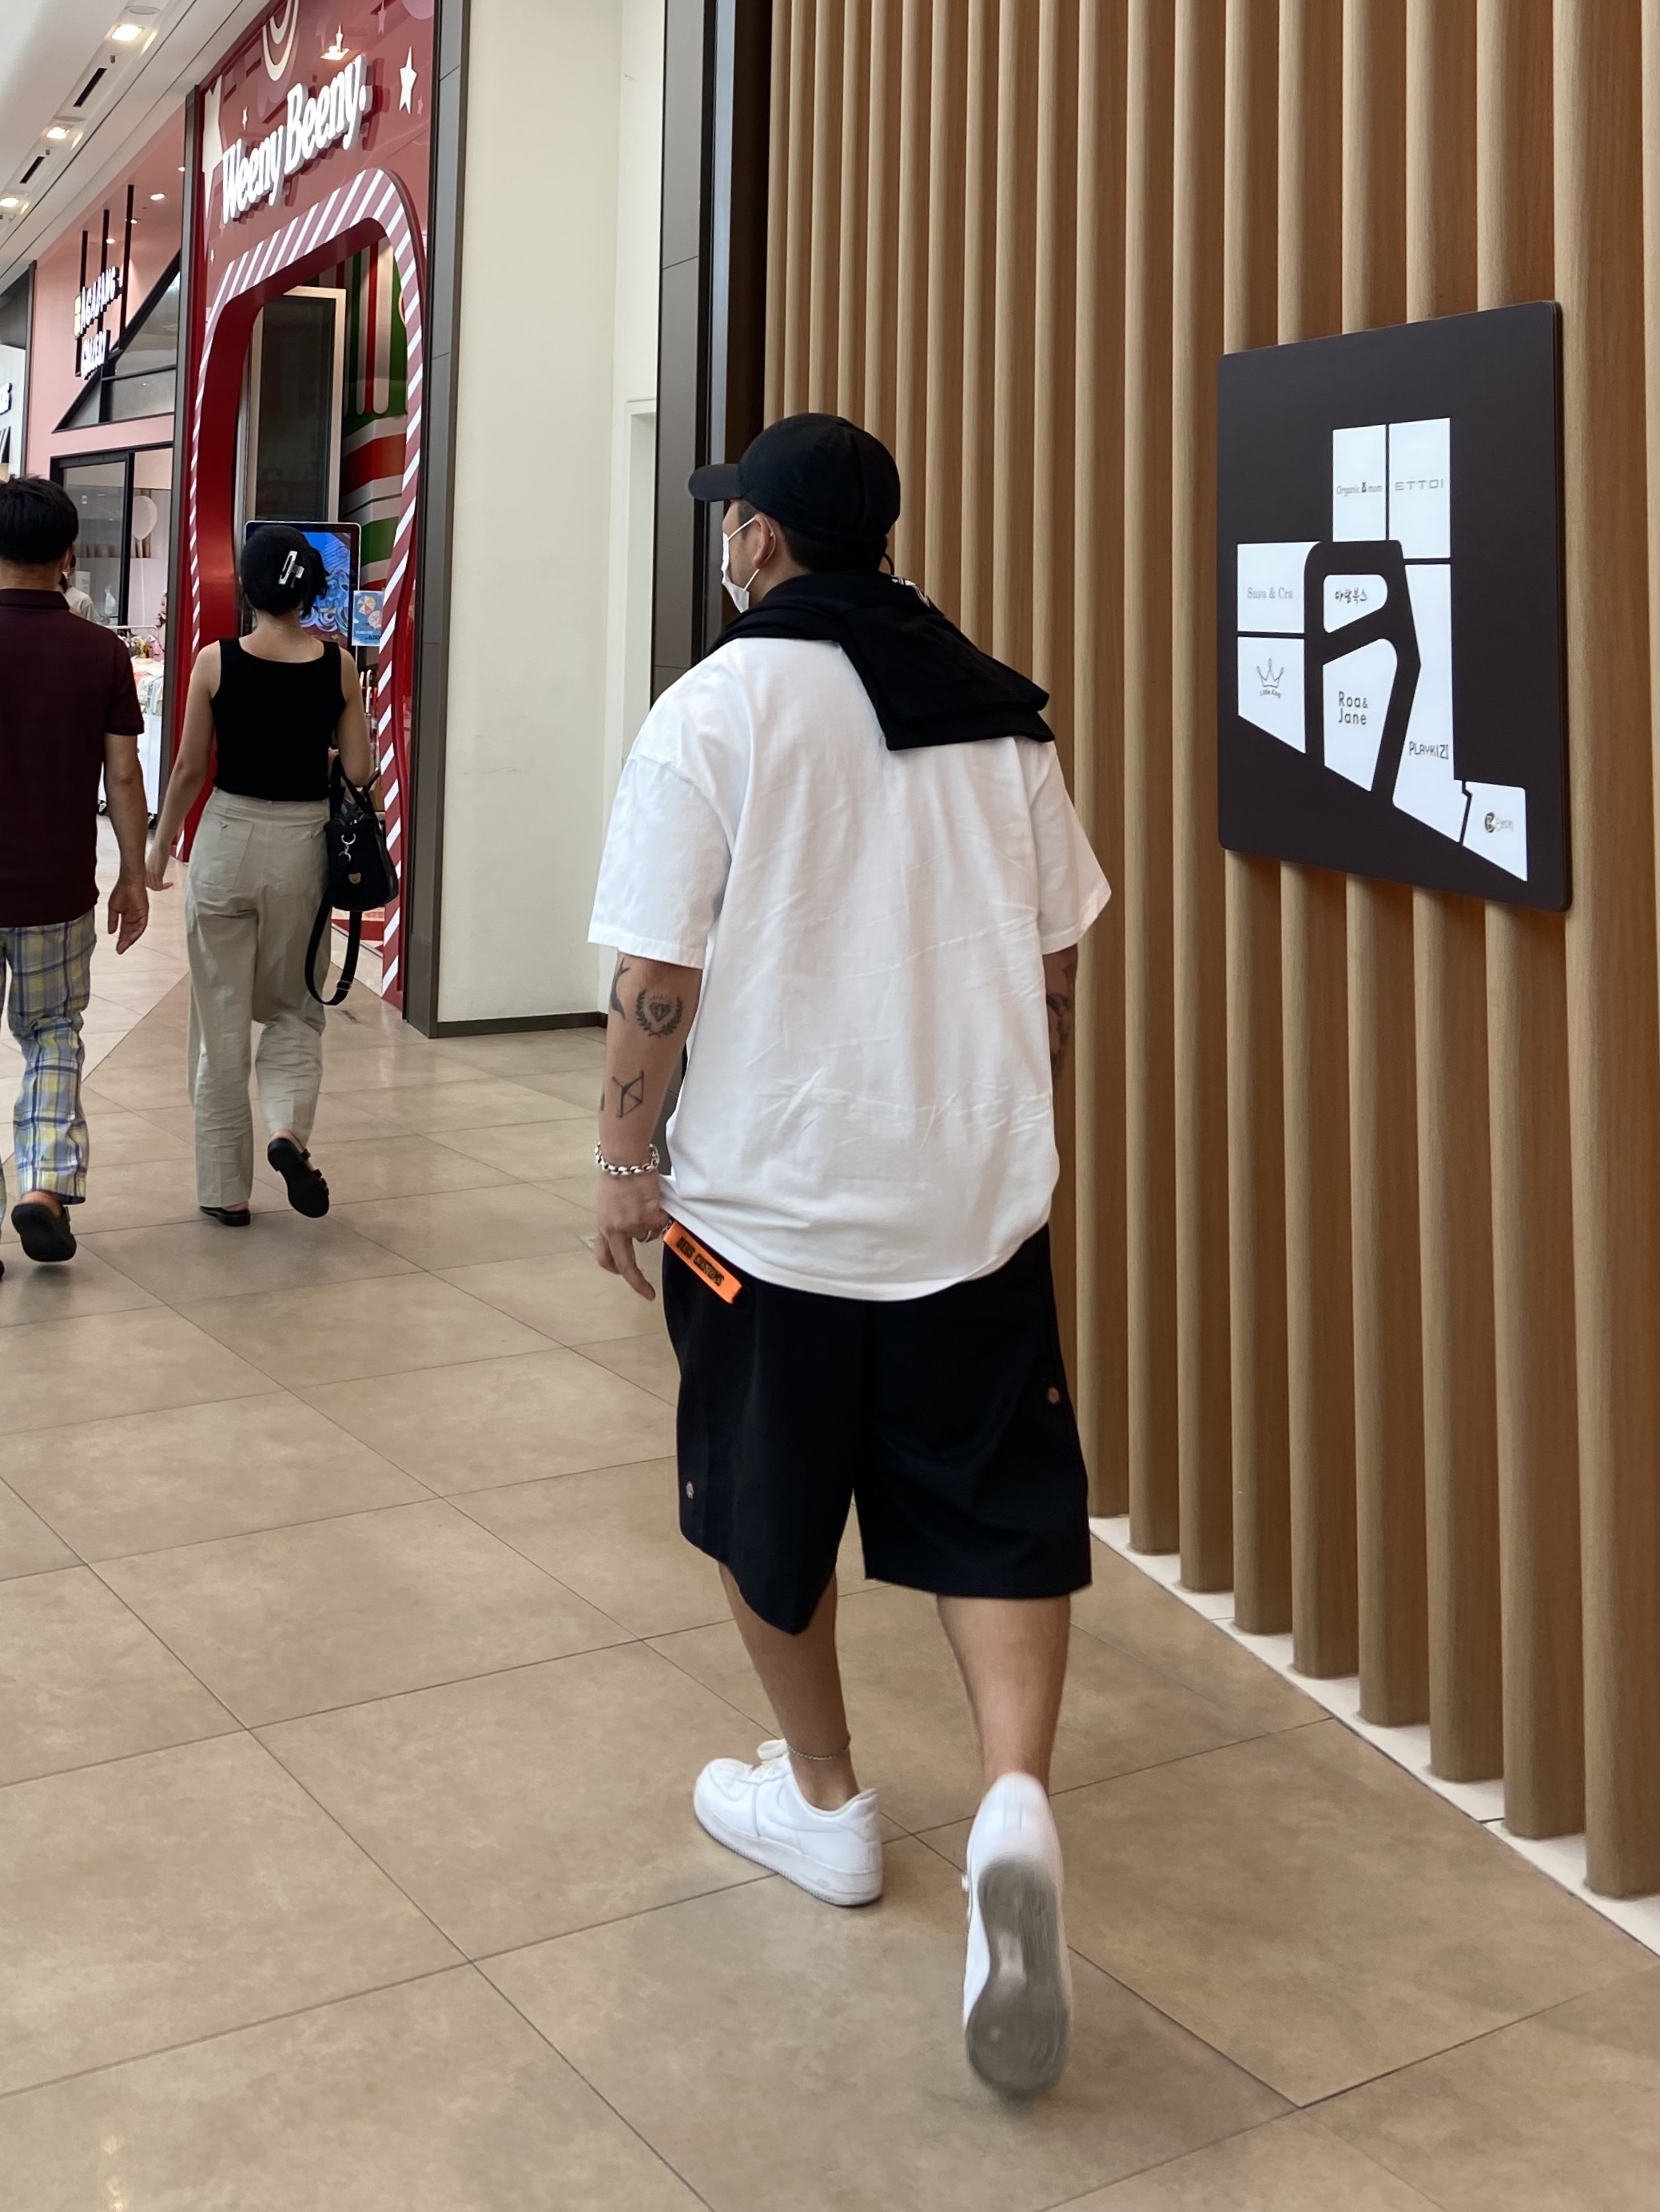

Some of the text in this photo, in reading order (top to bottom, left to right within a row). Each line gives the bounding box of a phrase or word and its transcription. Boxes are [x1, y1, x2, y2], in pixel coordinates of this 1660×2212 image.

[223, 54, 367, 225] Weeny Beeny.
[1336, 484, 1359, 496] Organic
[1395, 479, 1444, 491] ETTOI
[1246, 587, 1293, 599] Susu & Cra
[1338, 707, 1367, 726] Jane
